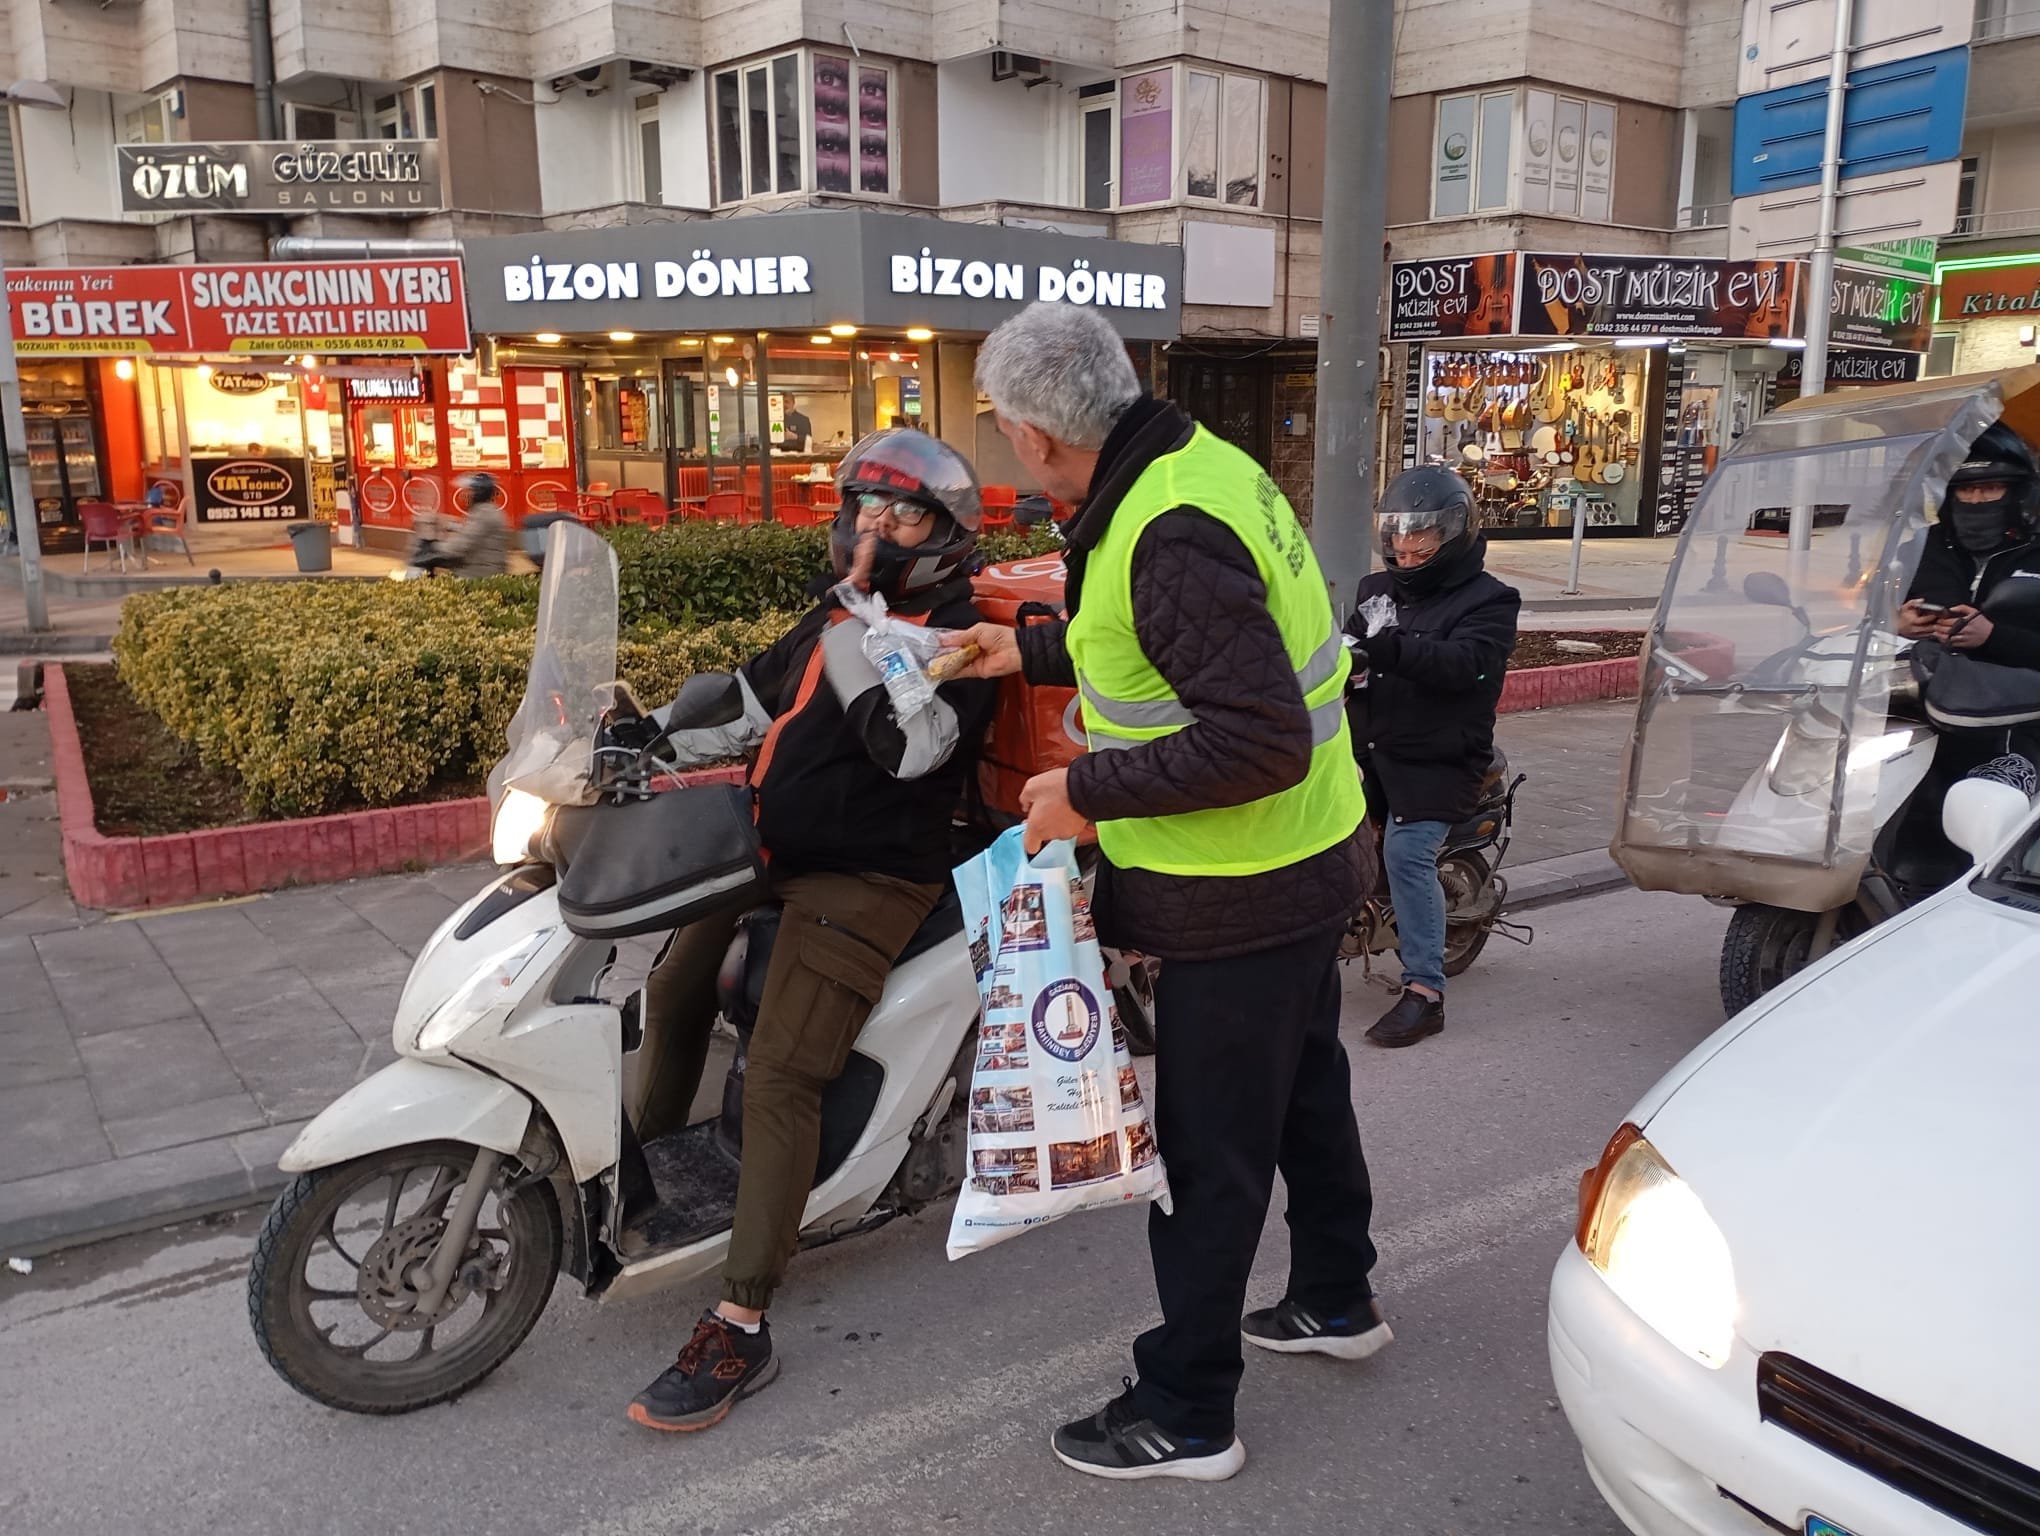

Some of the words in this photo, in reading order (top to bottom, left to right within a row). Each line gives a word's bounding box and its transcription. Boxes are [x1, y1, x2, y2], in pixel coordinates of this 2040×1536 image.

[272, 143, 420, 183] GÜZELLİK
[132, 156, 248, 199] ÖZÜM
[278, 190, 422, 204] SALONU
[80, 274, 114, 291] Yeri
[191, 268, 374, 308] SICAKCININ
[503, 254, 640, 301] BİZON
[654, 249, 812, 298] DÖNER
[890, 246, 1024, 300] BİZON
[1038, 258, 1167, 310] DÖNER
[1395, 261, 1473, 298] DOST
[1537, 267, 1624, 306] DOST
[1624, 263, 1720, 312] MÜZİK
[21, 295, 176, 336] BÖREK
[1397, 297, 1440, 318] MÜZİK
[1829, 280, 1852, 315] ST
[1850, 280, 1897, 326] MÜZİK
[221, 312, 280, 335] TAZE
[283, 311, 348, 334] TATLI
[351, 309, 428, 333] FIRINI
[1594, 324, 1613, 333] 0342
[1615, 324, 1629, 333] 336
[1630, 324, 1640, 333] 44
[1641, 324, 1651, 333] 97
[249, 340, 275, 350] Zafer
[277, 338, 313, 350] GÖREN
[324, 340, 351, 349] 0536
[353, 339, 373, 349] 483
[375, 339, 389, 349] 47
[391, 338, 405, 348] 82
[1832, 356, 1879, 380] MÜZİK
[214, 375, 242, 388] TAT
[213, 475, 250, 491] TAT
[281, 505, 296, 517] 33
